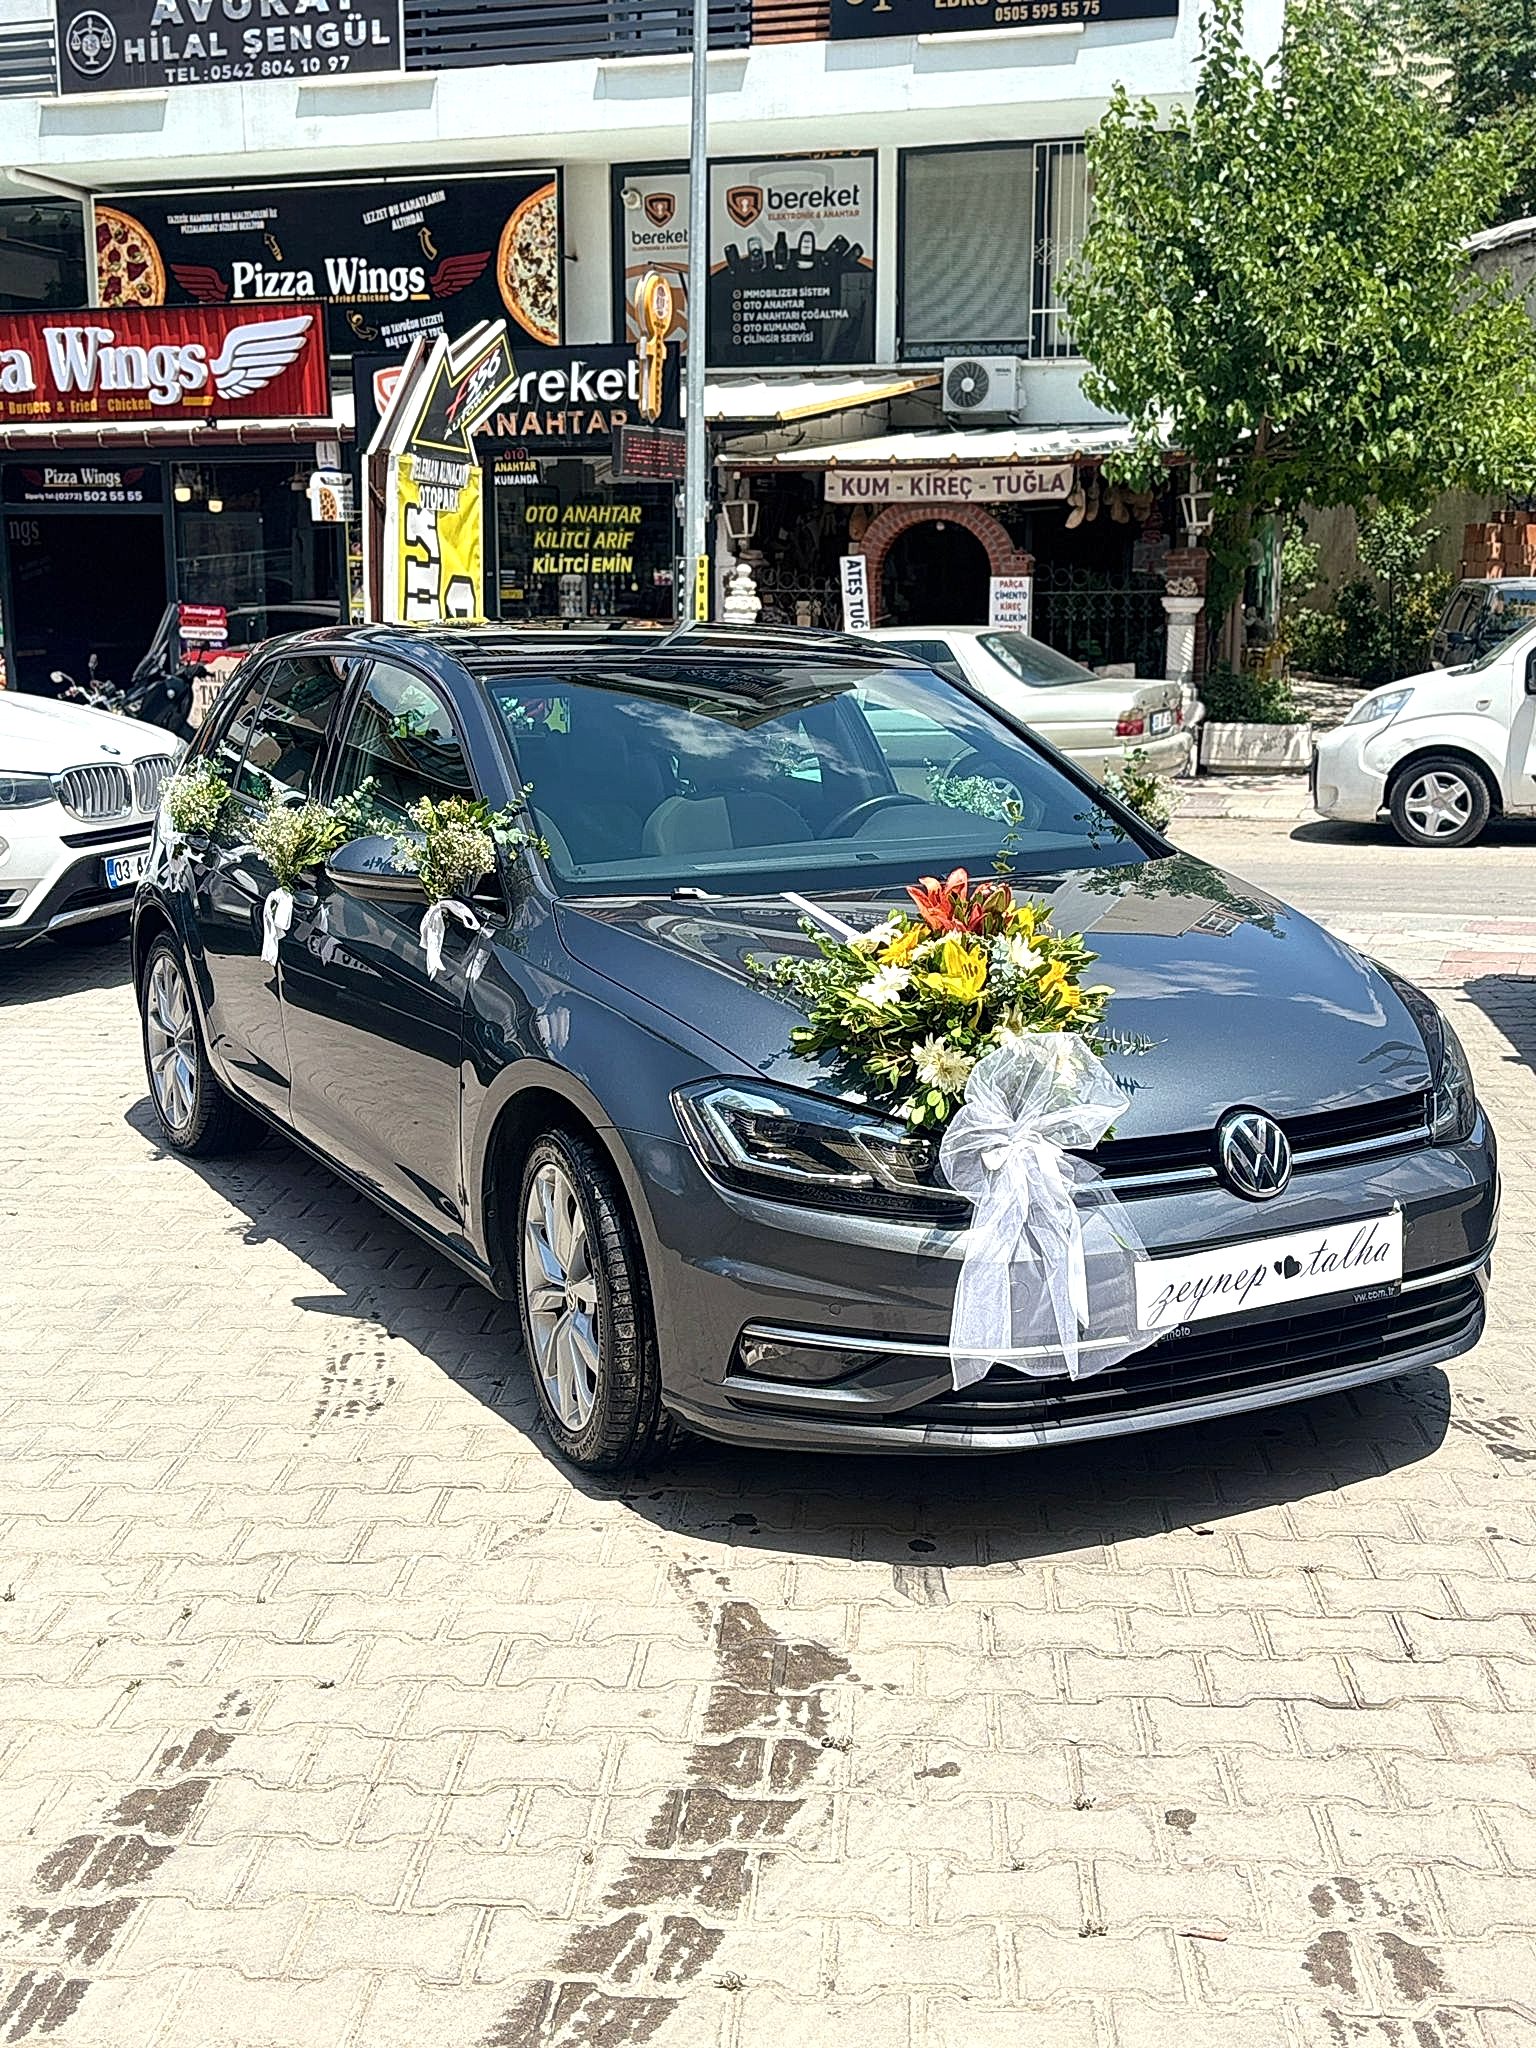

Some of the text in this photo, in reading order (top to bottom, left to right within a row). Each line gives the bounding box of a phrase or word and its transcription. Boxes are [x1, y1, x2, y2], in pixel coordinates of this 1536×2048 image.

[995, 6, 1028, 22] 0505
[1032, 3, 1058, 19] 595
[1061, 2, 1079, 17] 55
[1082, 0, 1100, 16] 75
[124, 14, 391, 64] HİLAL ŞENGÜL
[260, 60, 295, 76] 804
[300, 57, 320, 73] 10
[327, 55, 350, 72] 97
[767, 184, 860, 210] bereket
[362, 207, 388, 225] LEZZET
[632, 229, 688, 245] bereket
[232, 257, 426, 302] Pizza Wings
[743, 299, 805, 310] OTO ANAHTAR
[743, 312, 755, 321] EV
[743, 322, 806, 333] OTO KUMANDA
[42, 326, 208, 405] Wings
[8, 401, 51, 415] Burgers
[70, 398, 98, 413] Fried
[107, 397, 152, 412] Chicken
[504, 449, 525, 460] OTO
[44, 467, 121, 488] Pizza Wings
[494, 461, 537, 473] ANAHTAR
[494, 474, 540, 486] KUMANDA
[841, 477, 890, 496] KUM
[910, 473, 973, 499] KİREÇ
[992, 470, 1066, 494] TUĞLA
[83, 490, 108, 502] 502
[109, 490, 125, 502] 55
[126, 490, 143, 501] 55
[525, 505, 642, 523] OTO ANAHTAR
[533, 526, 635, 549] KİLİTCİ ARİF
[532, 552, 633, 574] KİLİTCİ EMİN
[845, 560, 863, 596] ATEŞ
[999, 580, 1024, 589] PARÇA
[115, 860, 130, 881] 03
[1146, 1222, 1391, 1327] zeynep talha
